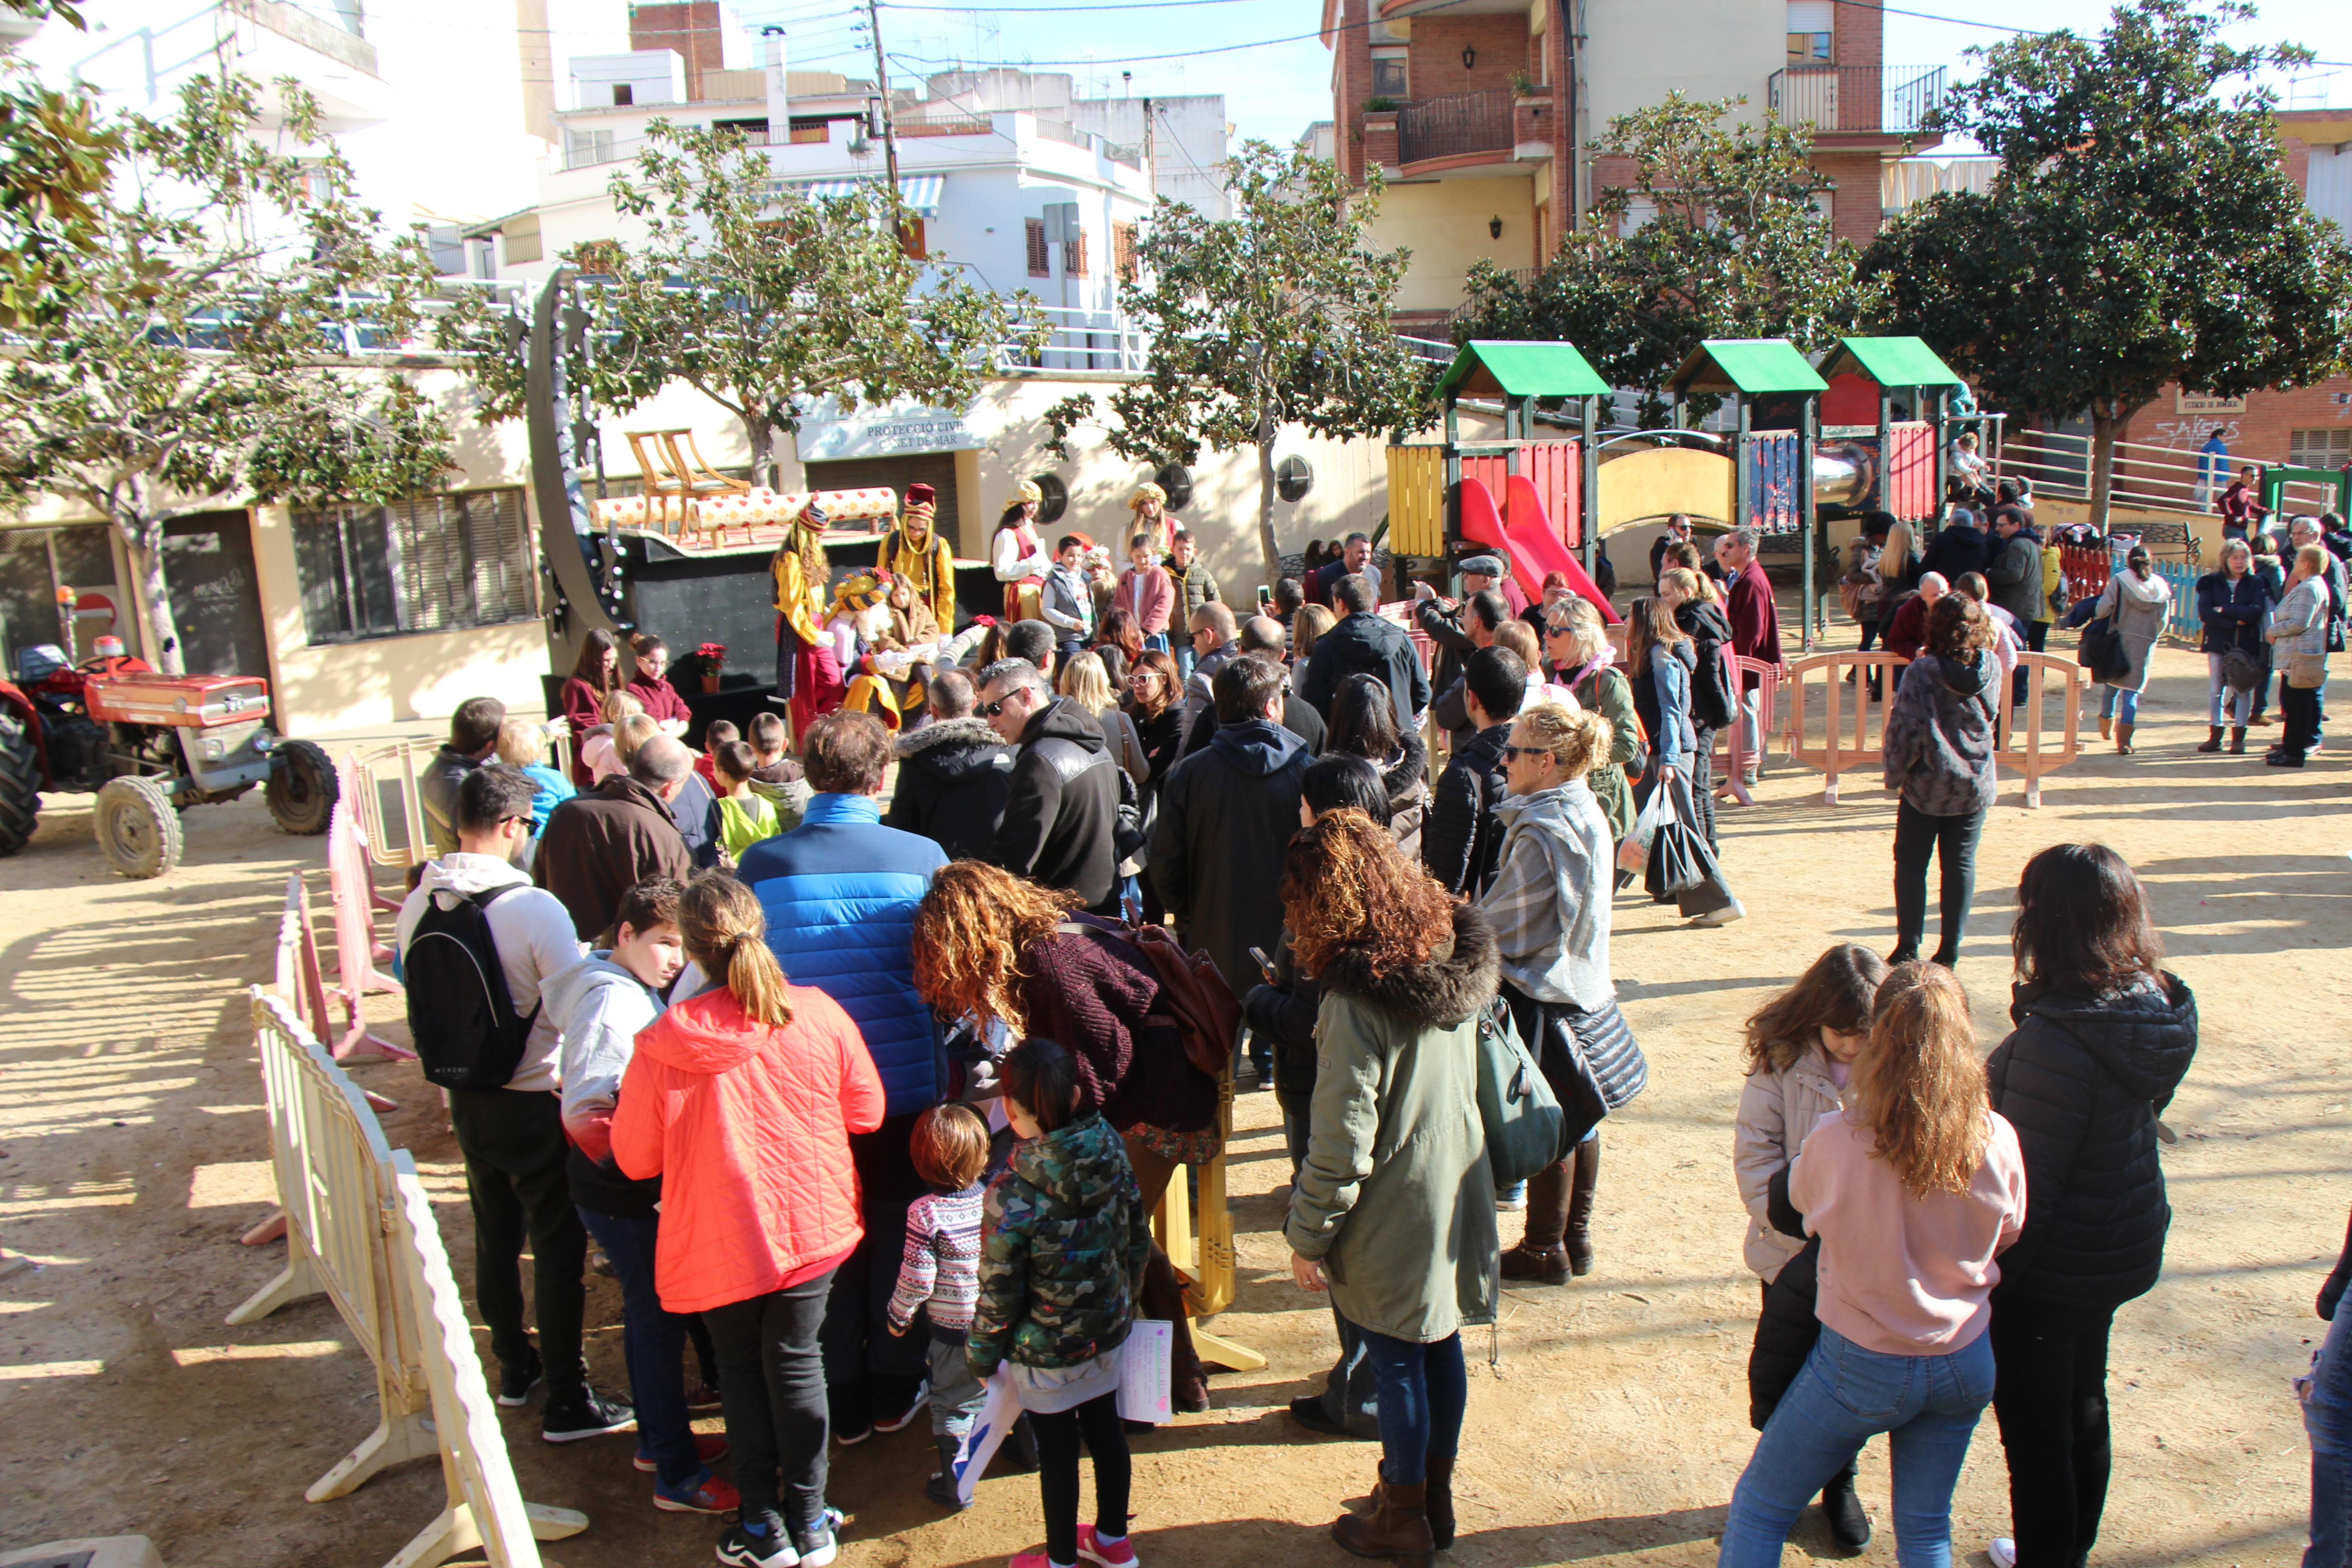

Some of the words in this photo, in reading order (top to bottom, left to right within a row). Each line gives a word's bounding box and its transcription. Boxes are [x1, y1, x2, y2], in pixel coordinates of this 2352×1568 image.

[867, 420, 933, 436] PROTECCIÓ
[937, 421, 966, 431] CIVIL
[879, 437, 914, 449] CANET
[917, 436, 931, 446] DE
[933, 435, 957, 445] MAR
